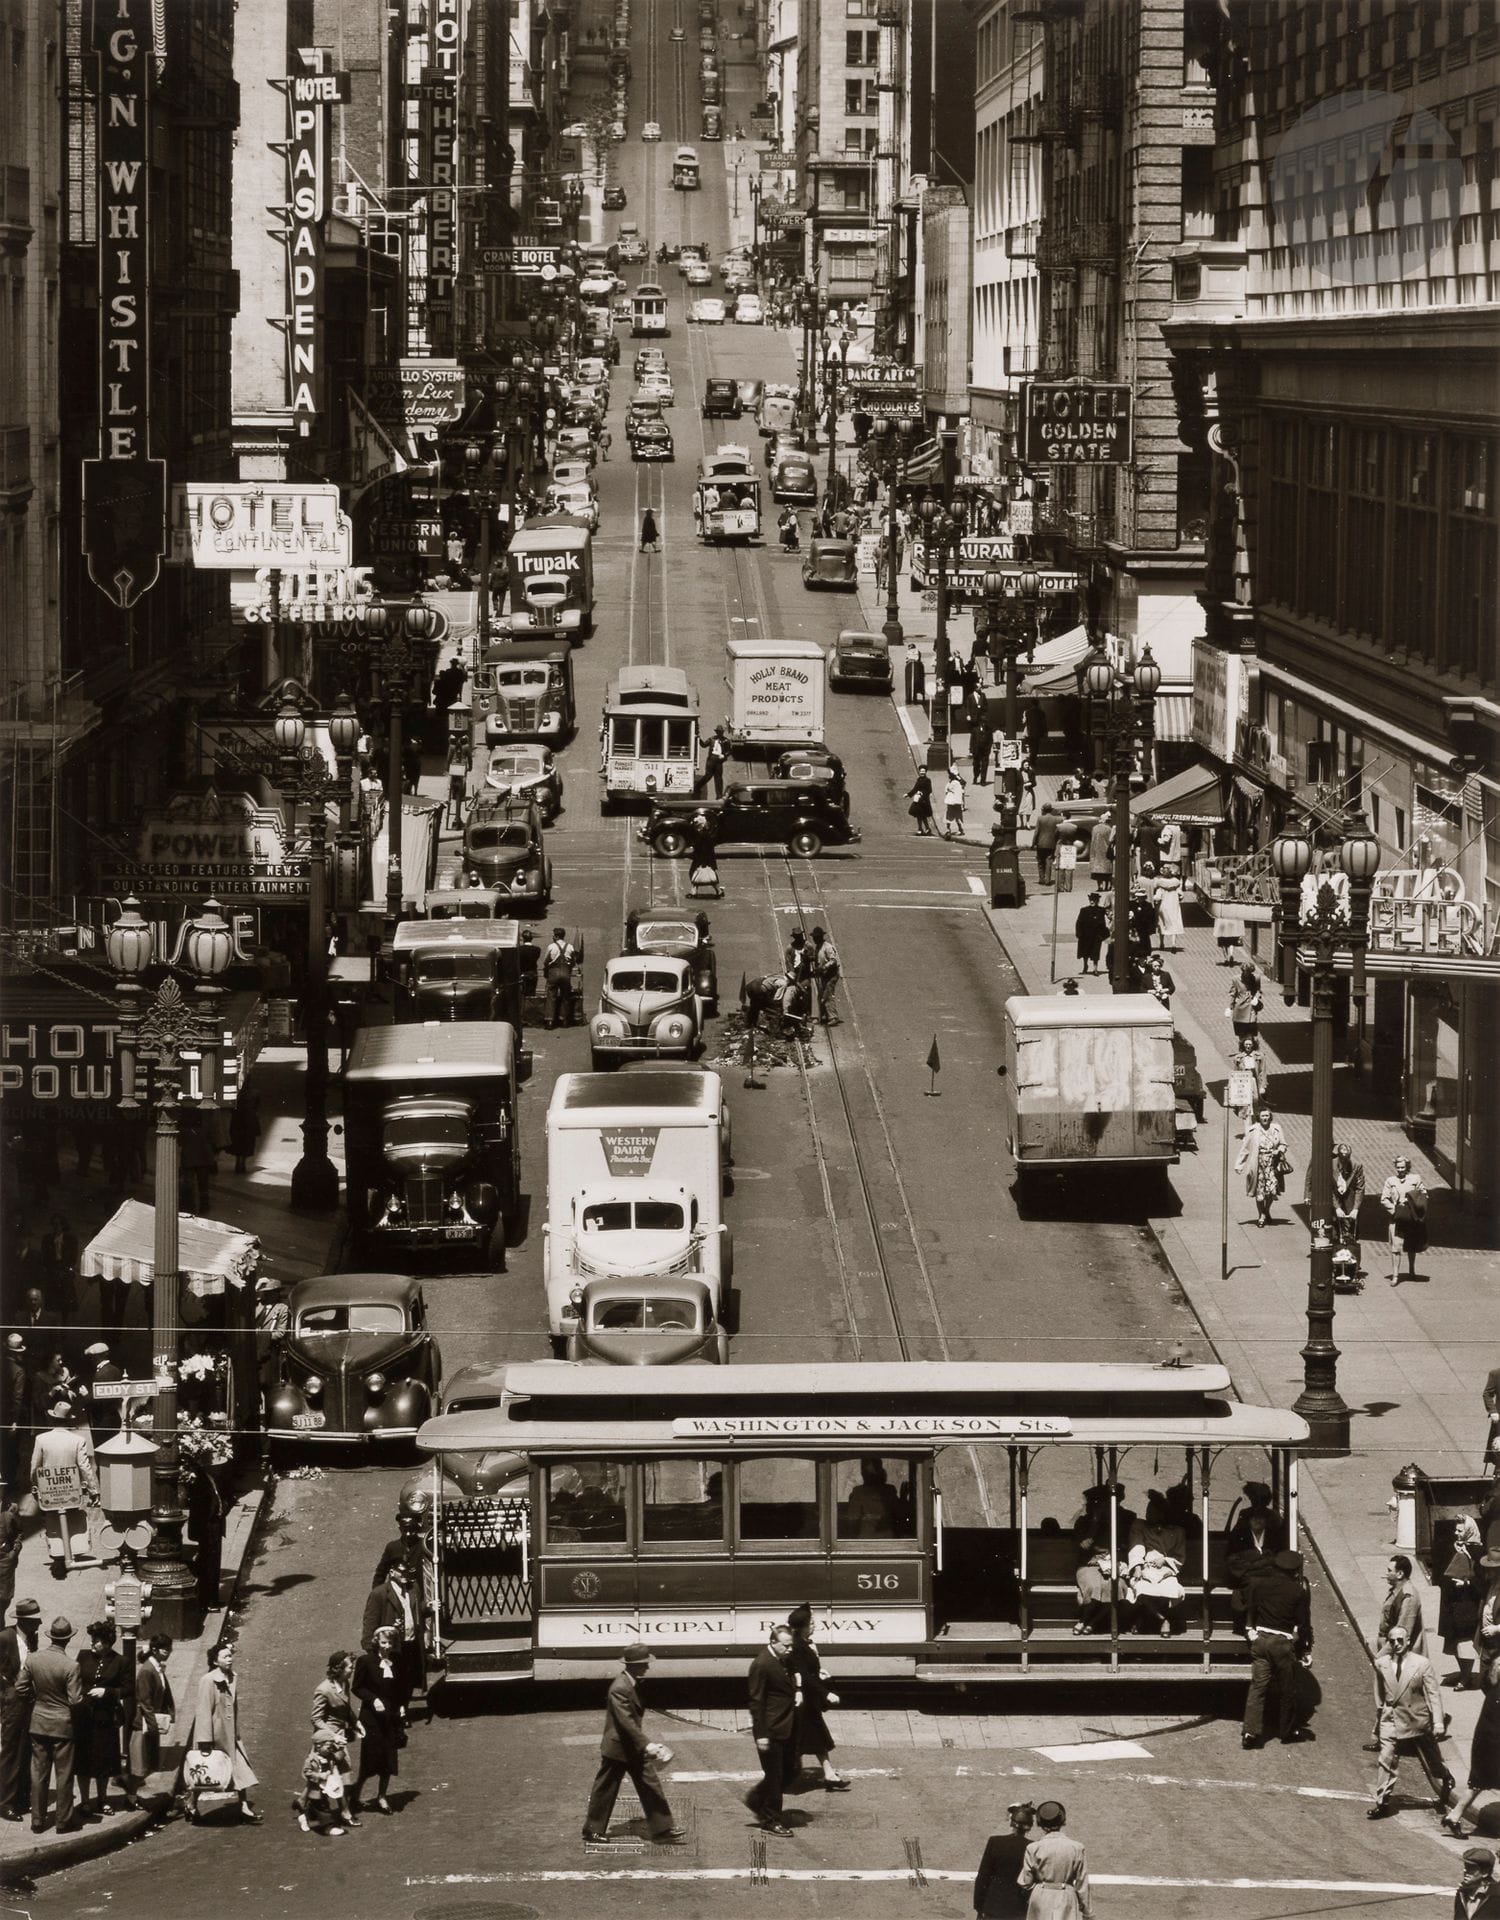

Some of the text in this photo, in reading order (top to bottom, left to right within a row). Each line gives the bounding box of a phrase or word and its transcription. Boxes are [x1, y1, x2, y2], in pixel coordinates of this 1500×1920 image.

[295, 77, 342, 101] HOTEL
[407, 86, 453, 100] OTEL
[432, 106, 453, 296] HERBERT
[511, 235, 540, 247] NITED
[293, 109, 316, 413] PASADENA
[483, 250, 557, 263] CRANE HOTEL
[105, 160, 141, 460] WHISTLE
[422, 369, 462, 383] SYSTEM
[465, 373, 489, 384] ANX
[847, 368, 880, 381] DANCE
[883, 368, 904, 381] ART
[416, 382, 455, 399] Lux
[860, 400, 920, 412] CHOCOLATES
[1032, 390, 1126, 418] HOTEL
[1041, 422, 1117, 439] GOLDEN
[1047, 443, 1111, 459] STATE
[955, 475, 1009, 485] BARBECU
[179, 494, 324, 533] HOTEL
[369, 522, 441, 536] WESTERN
[213, 531, 342, 556] CONTINENTAL
[380, 538, 428, 552] UNION
[914, 543, 1015, 560] RETAURAN
[513, 551, 580, 575] Trupak
[928, 576, 984, 588] GLDEN
[749, 666, 809, 685] HOLLY BRAND
[765, 682, 792, 691] MEAT
[751, 695, 804, 704] PRODUCTS
[150, 833, 269, 859] POWELL
[116, 864, 301, 876] SELECTED FEATURES NEWS
[113, 880, 311, 894] OUTSTANDING ENTERTAINMENT
[57, 1106, 113, 1119] TRAVEL
[606, 1136, 656, 1146] WESTERN
[613, 1146, 647, 1155] DAIRY
[95, 1383, 155, 1397] EDDY ST.
[692, 1419, 1060, 1432] WASHINGTON & JACKSON Sts.
[38, 1466, 77, 1478] NO LEFT
[45, 1475, 72, 1486] TURN
[856, 1573, 899, 1590] 516
[582, 1619, 882, 1635] MUNICIPAL RLWAY
